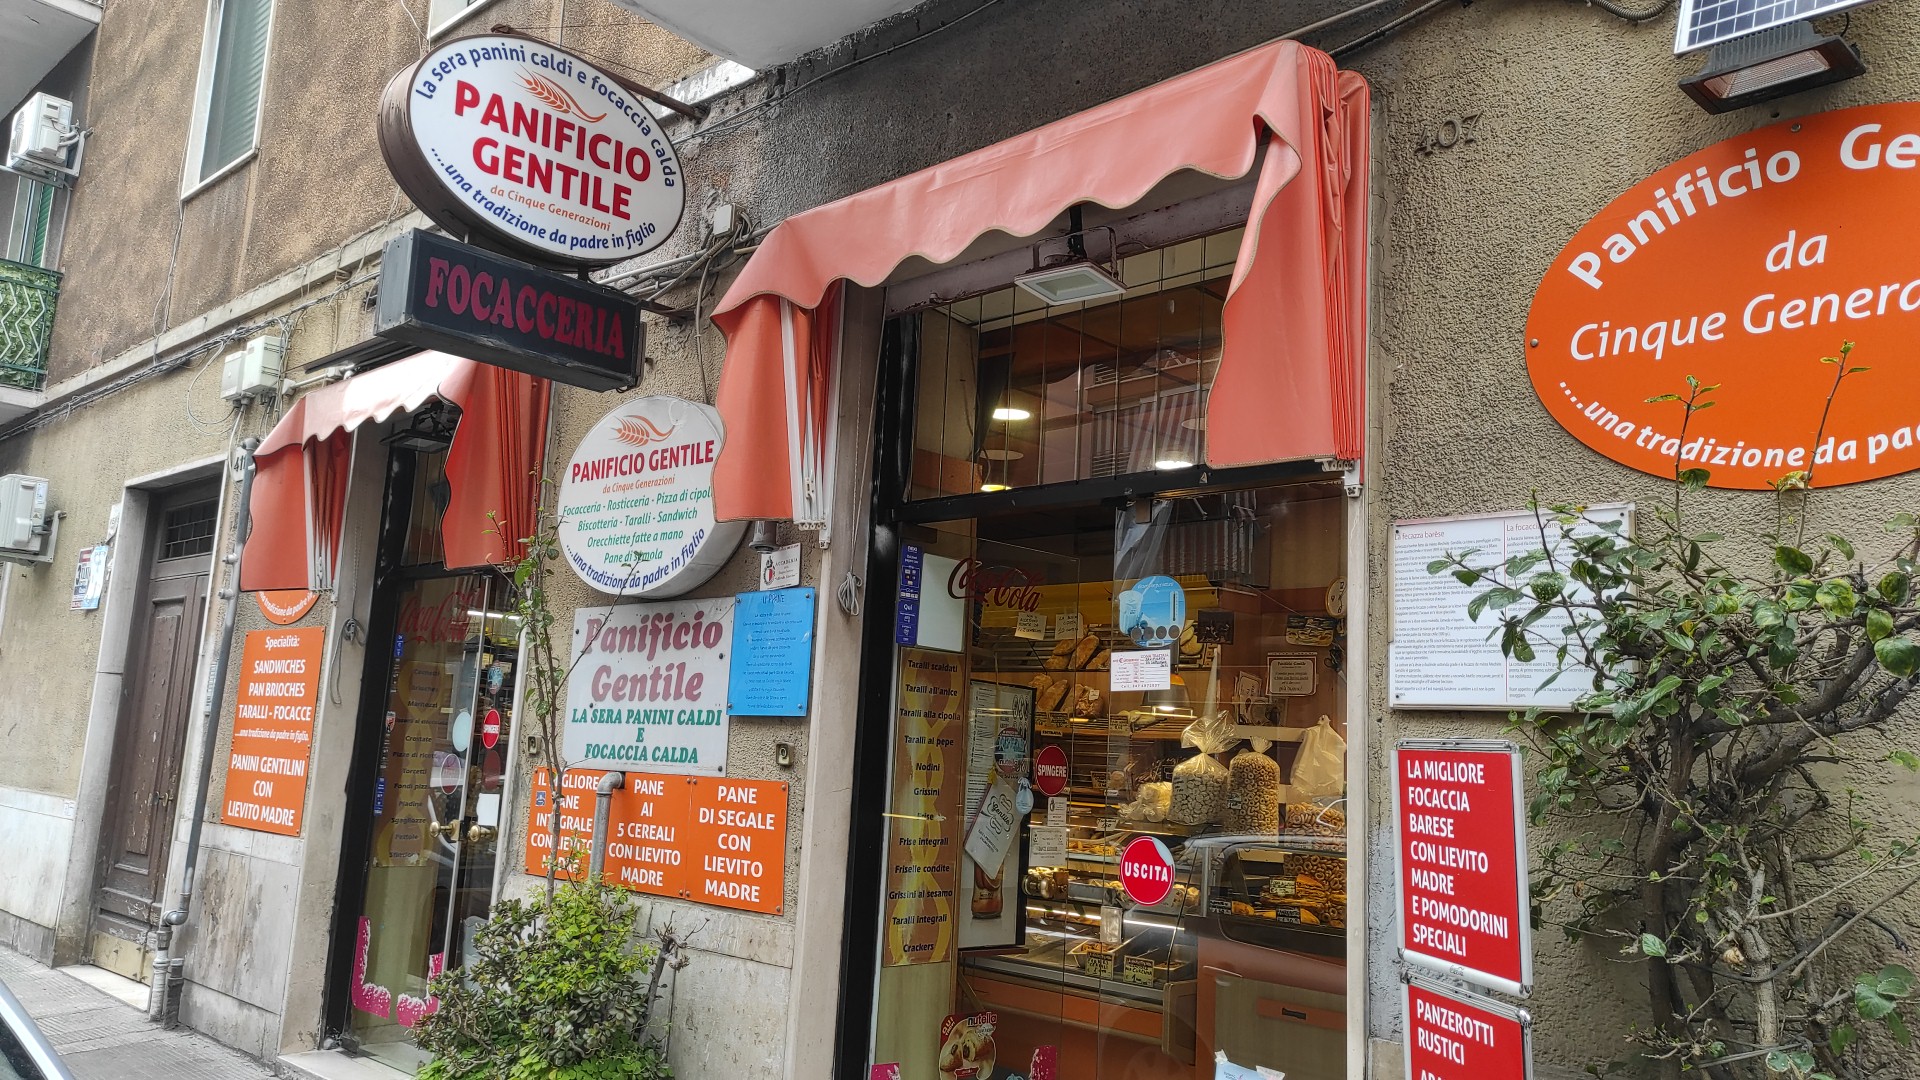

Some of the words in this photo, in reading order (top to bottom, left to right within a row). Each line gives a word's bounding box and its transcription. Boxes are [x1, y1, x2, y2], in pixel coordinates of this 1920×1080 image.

[415, 80, 436, 100] la
[431, 51, 467, 83] sera
[469, 42, 526, 67] panini
[531, 50, 573, 77] caldi
[577, 71, 587, 84] e
[590, 75, 652, 136] focaccia
[651, 138, 677, 188] calda
[454, 79, 651, 182] PANIFICIO
[472, 136, 632, 221] GENTILE
[490, 184, 504, 198] da
[507, 188, 546, 212] Cinque
[548, 203, 611, 232] Generazioni
[1567, 147, 1801, 290] Panificio
[472, 188, 546, 240] tradizione
[549, 227, 567, 246] da
[570, 232, 609, 250] padre
[611, 231, 625, 248] in
[623, 220, 657, 250] figlio
[1765, 230, 1828, 273] da
[424, 256, 625, 360] FOCACCERIA
[1569, 311, 1727, 362] Cinque
[1636, 425, 1805, 468] tradizione
[1815, 437, 1858, 465] da
[1867, 424, 1920, 465] pa
[571, 451, 645, 484] PANIFICIO
[648, 439, 715, 471] GENTILE
[602, 484, 611, 494] da
[611, 482, 634, 494] Cinque
[635, 473, 675, 490] Generazioni
[562, 501, 601, 516] Focacceria
[606, 494, 650, 512] Rosticceria
[656, 491, 679, 505] Pizza
[679, 489, 689, 502] di
[577, 516, 618, 532] Biscotteria
[624, 511, 651, 526] Taralli
[657, 506, 698, 522] Sandwich
[1506, 524, 1514, 532] La
[1515, 523, 1541, 531] focacci
[587, 532, 630, 548] Orecchiette
[630, 531, 652, 549] fatte
[652, 533, 658, 541] a
[659, 529, 684, 541] mano
[586, 564, 628, 589] tradizione
[629, 574, 641, 588] da
[642, 564, 669, 590] padre
[670, 556, 681, 571] in
[681, 527, 705, 568] figlio
[604, 551, 624, 564] Pane
[624, 549, 633, 563] di
[633, 548, 664, 562] smola
[264, 636, 301, 651] Specialità:
[580, 610, 724, 662] Panificio
[253, 659, 306, 675] SANDWICHES
[908, 659, 931, 670] Taralli
[931, 661, 958, 673] scaldati
[248, 682, 265, 697] PAN
[265, 682, 305, 698] BRIOCHES
[591, 661, 705, 702] Gentile
[905, 683, 928, 694] Taralli
[238, 704, 269, 721] TARALLI
[273, 704, 312, 722] FOCACCE
[572, 708, 590, 724] LA
[590, 708, 624, 725] SERA
[625, 709, 674, 725] PANINI
[677, 708, 723, 726] CALDI
[900, 708, 922, 718] Taralli
[923, 709, 937, 719] alla
[937, 711, 961, 722] cipolla
[635, 727, 645, 743] E
[904, 735, 927, 745] Taralli
[927, 736, 935, 745] al
[936, 737, 954, 747] pepe
[585, 743, 650, 762] FOCACCIA
[651, 744, 699, 764] CALDA
[231, 753, 259, 773] PANINI
[260, 756, 305, 778] GENTILINI
[916, 761, 940, 772] Nodini
[1037, 764, 1067, 778] SPINGERE
[1406, 759, 1422, 780] LA
[1424, 760, 1485, 784] MIGLIORE
[538, 771, 547, 786] IL
[549, 773, 600, 791] GLIORE
[634, 779, 665, 796] PANE
[253, 780, 273, 799] CON
[717, 785, 758, 805] PANE
[913, 786, 940, 797] Grissini
[1408, 785, 1470, 812] FOCACCIA
[227, 800, 261, 821] LIEVITO
[260, 805, 295, 827] MADRE
[640, 801, 653, 817] AI
[699, 807, 716, 824] DI
[717, 809, 775, 831] SEGALE
[536, 812, 593, 833] INGRALE
[617, 824, 625, 838] 5
[627, 822, 675, 842] CEREALI
[1409, 813, 1454, 839] BARESE
[530, 832, 553, 848] CON
[717, 833, 751, 852] CON
[899, 837, 917, 846] Frise
[918, 838, 949, 847] integrali
[608, 842, 634, 859] CON
[635, 844, 681, 866] LIEVITO
[1410, 840, 1437, 864] CON
[1438, 844, 1489, 873] LIEVITO
[621, 866, 664, 887] MADRE
[704, 855, 763, 878] LIEVITO
[895, 865, 921, 874] Friselle
[923, 864, 950, 873] condite
[1124, 861, 1169, 883] USCITA
[704, 878, 760, 903] MADRE
[1411, 867, 1455, 896] MADRE
[889, 890, 917, 900] Grissini
[917, 890, 925, 898] al
[926, 890, 953, 898] sesamo
[892, 915, 915, 925] Taralli
[916, 914, 947, 925] integrali
[1412, 895, 1420, 915] E
[1421, 897, 1508, 939] POMODORINI
[903, 942, 934, 953] Crackers
[1412, 922, 1466, 957] SPECIALI
[967, 1011, 998, 1027] nutella
[1416, 998, 1494, 1048] PANZEROTTI
[1418, 1026, 1465, 1066] RUSTICI
